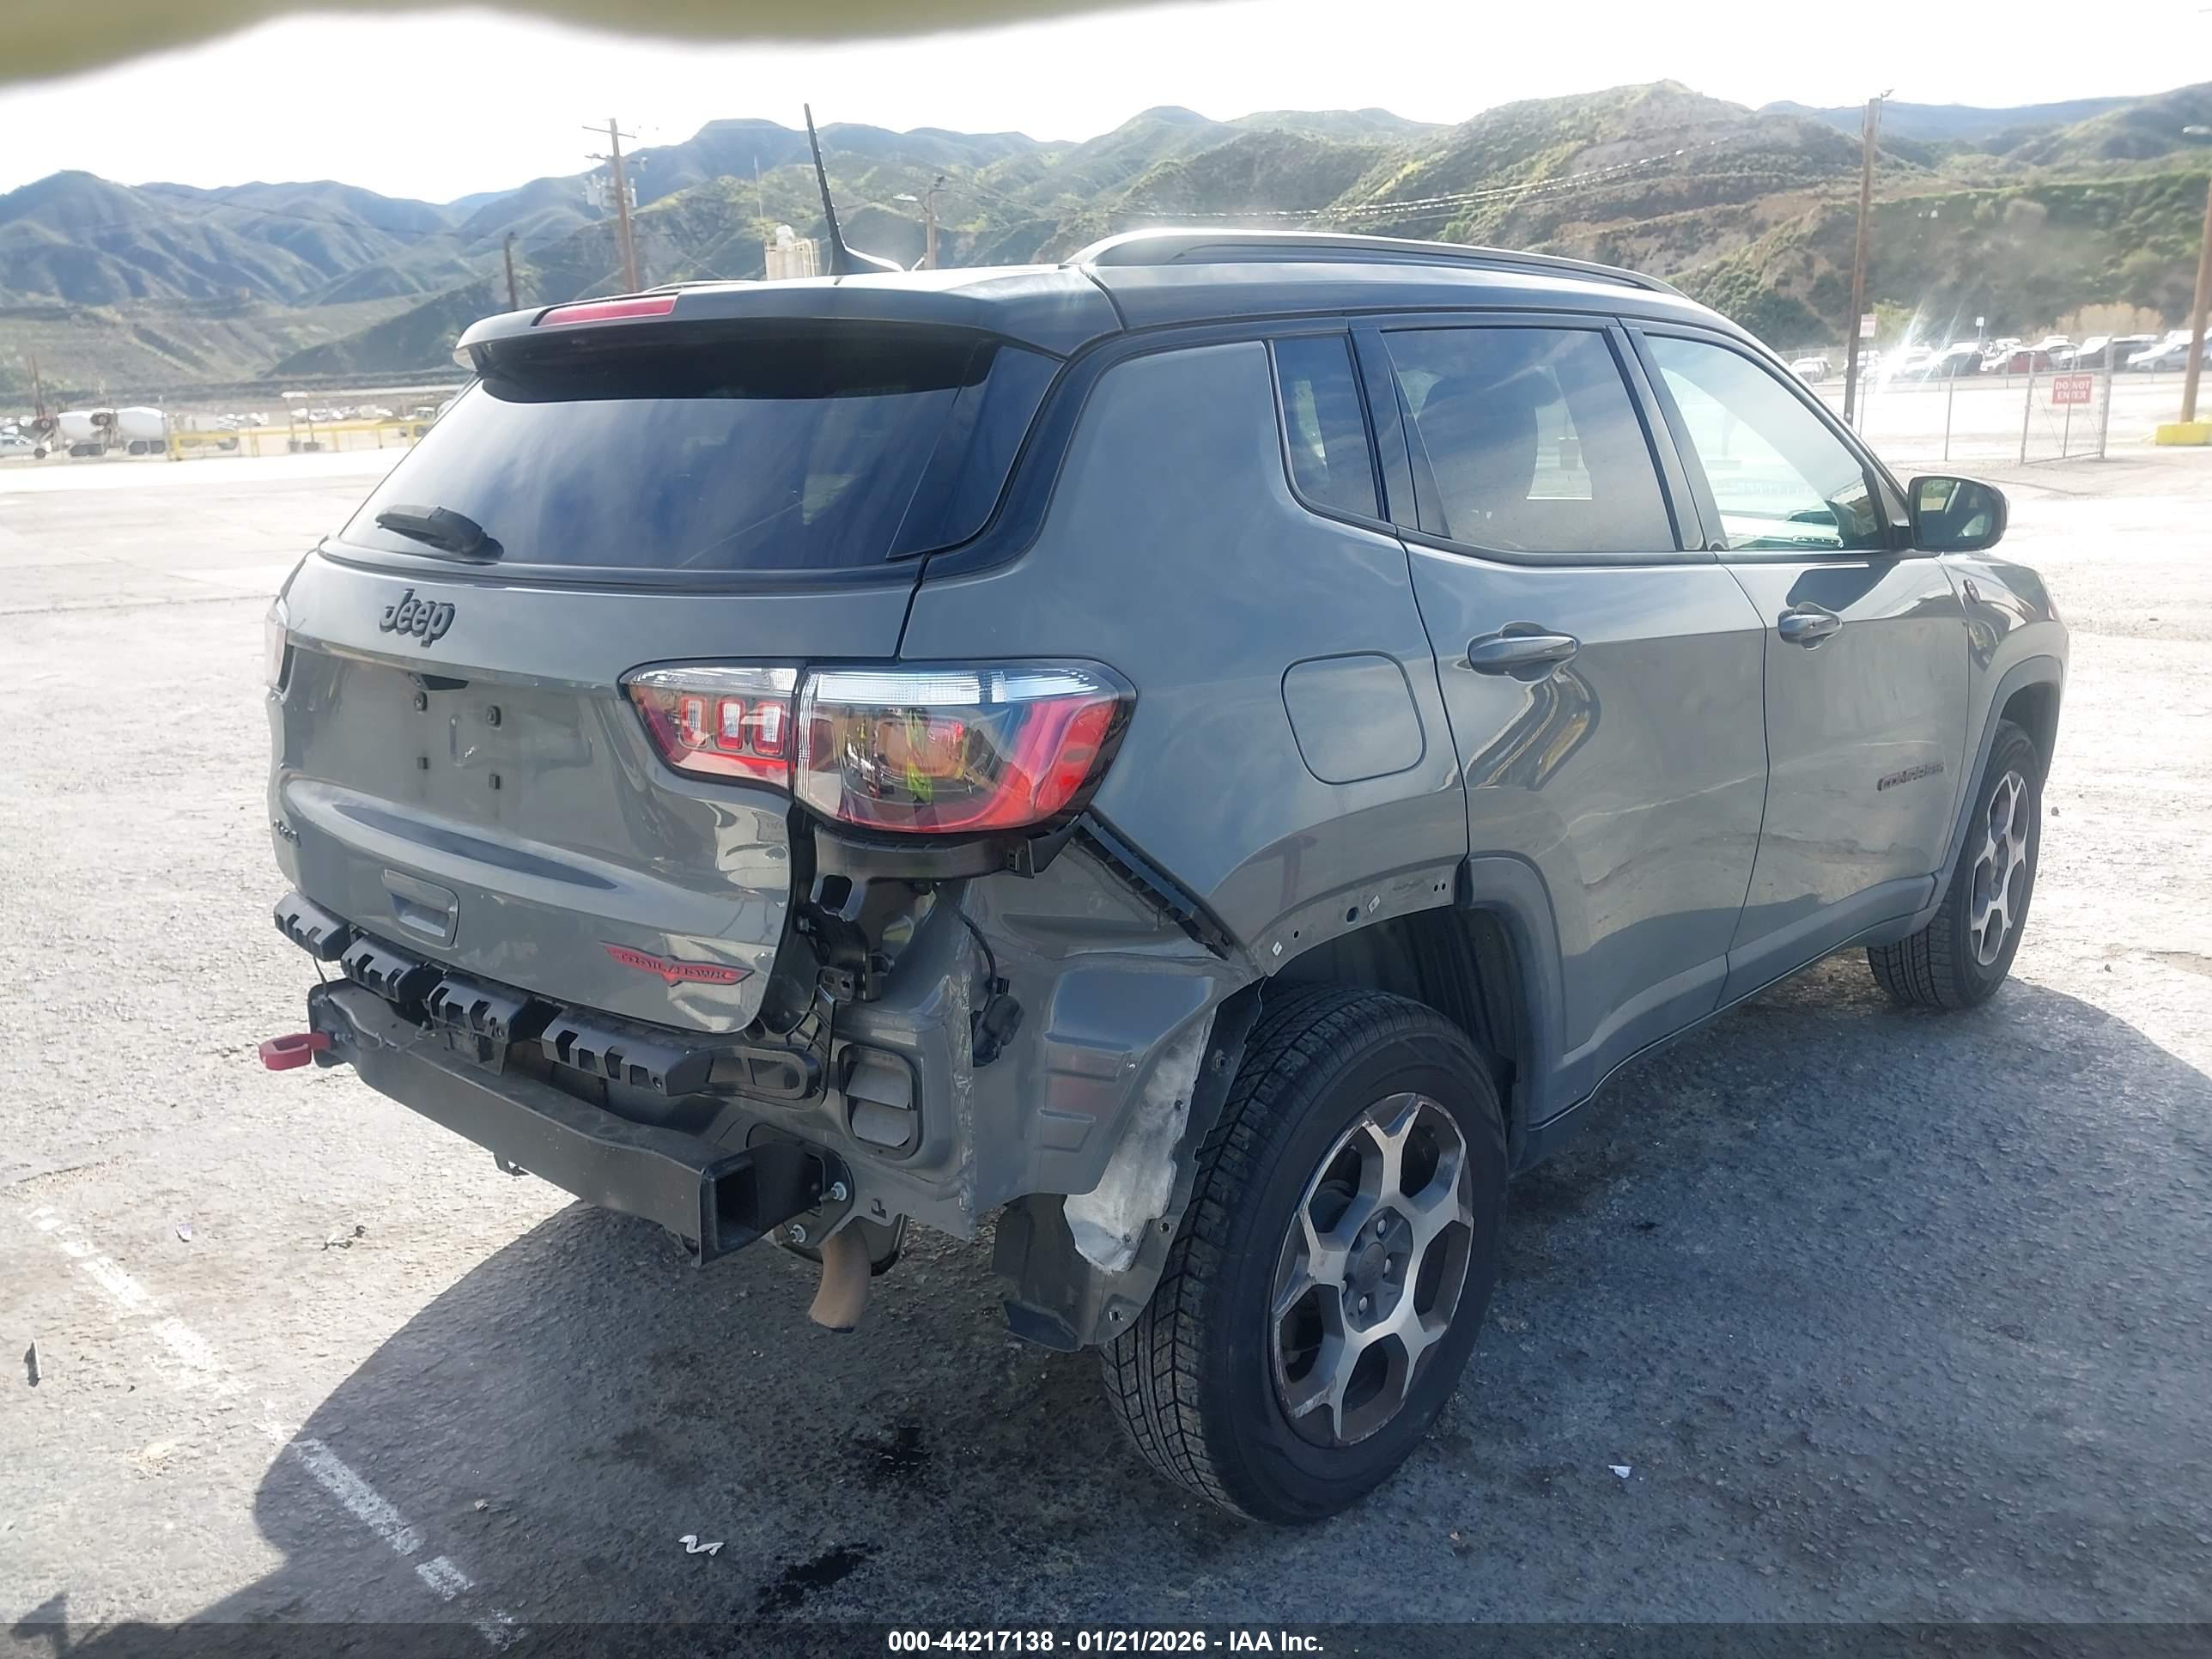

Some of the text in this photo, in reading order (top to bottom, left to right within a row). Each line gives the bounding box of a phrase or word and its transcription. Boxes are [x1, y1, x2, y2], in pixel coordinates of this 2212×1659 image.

[2055, 380, 2090, 391] DO NOT
[380, 588, 456, 647] Jeep
